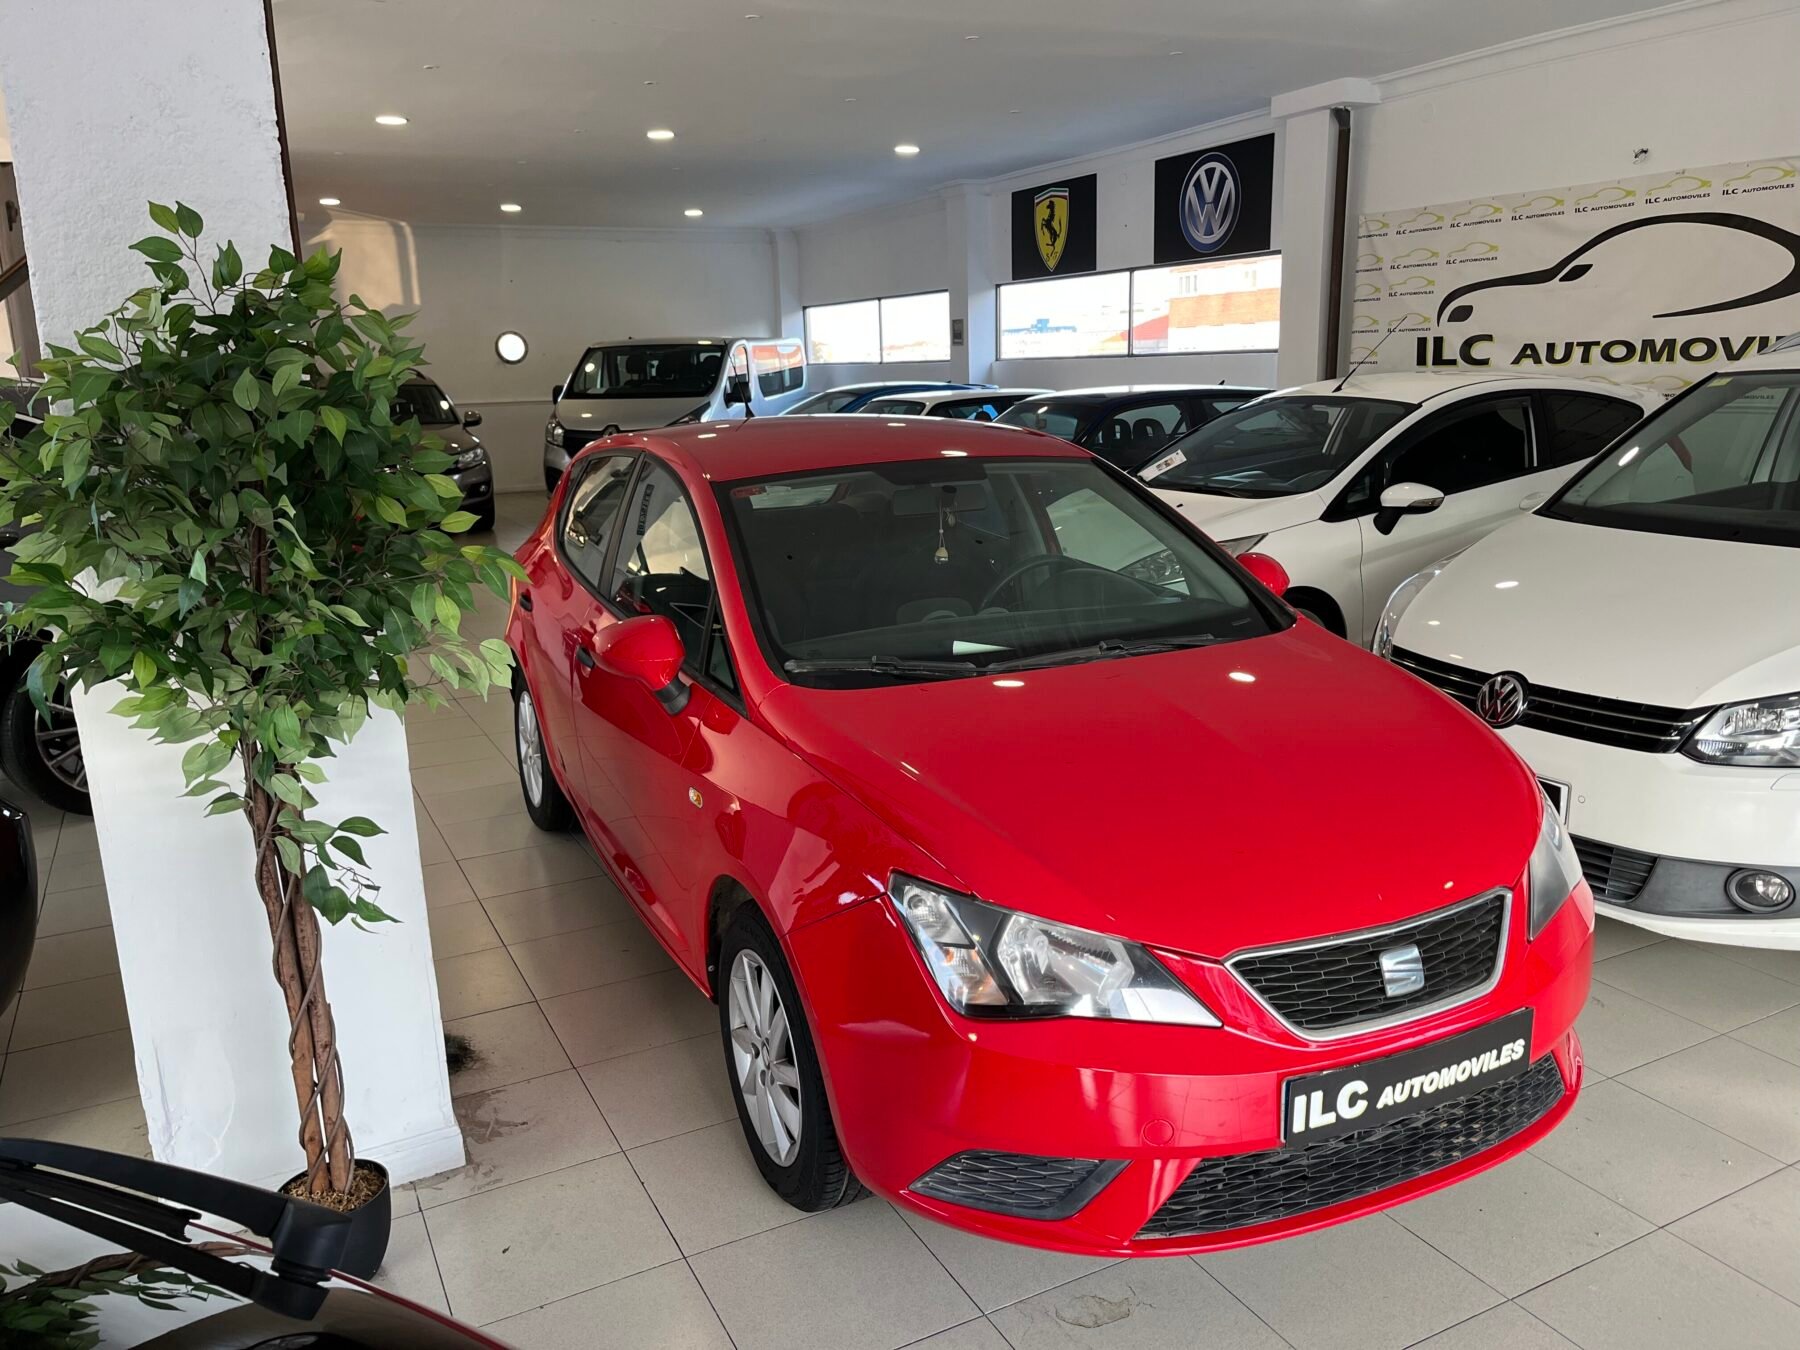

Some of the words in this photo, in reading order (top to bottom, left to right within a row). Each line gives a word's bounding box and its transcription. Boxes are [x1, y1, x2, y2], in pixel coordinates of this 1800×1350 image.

[1721, 188, 1738, 196] ILC
[1741, 183, 1795, 194] AUTOMOVILES
[1645, 197, 1660, 205] ILC
[1662, 192, 1711, 203] AUTOMOVILES
[1590, 202, 1635, 212] AUTOMOVILES
[1525, 211, 1565, 220] AUTOMOVILES
[1463, 218, 1502, 227] AUTOMOVILES
[1458, 256, 1498, 264] AUTOMOVILES
[1416, 334, 1494, 367] ILC
[1511, 335, 1787, 364] AUTOMOVI
[1292, 1080, 1369, 1134] ILC
[1375, 1038, 1526, 1110] AUTOMOVILES
